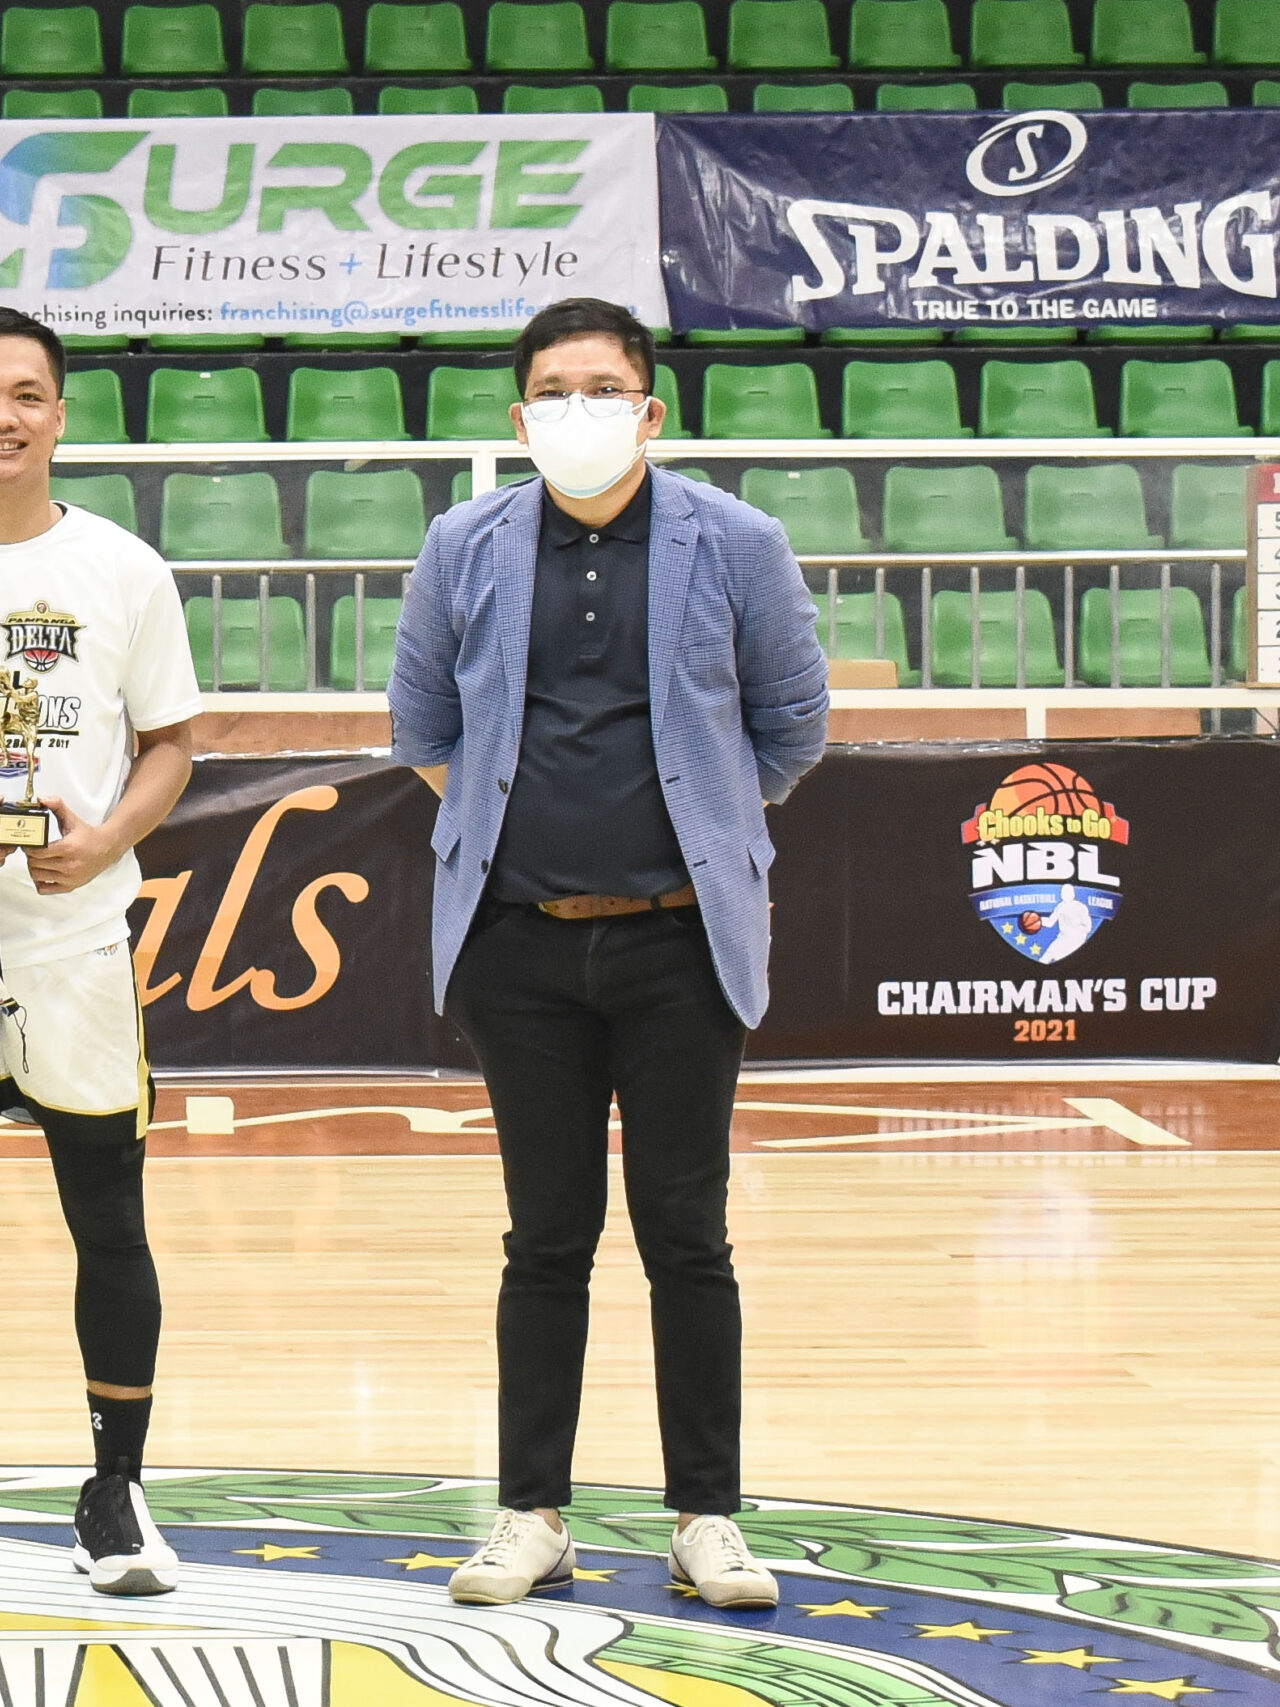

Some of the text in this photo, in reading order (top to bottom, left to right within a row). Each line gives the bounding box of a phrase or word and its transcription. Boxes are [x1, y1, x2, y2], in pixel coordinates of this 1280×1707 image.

[152, 244, 327, 281] Fitness
[376, 241, 579, 287] Lifestyle
[786, 191, 1280, 302] SPALDING
[114, 302, 212, 329] inquiries:
[913, 298, 1157, 320] TRUE TO THE GAME
[11, 624, 73, 651] DELTA
[978, 806, 1112, 844] Chooks to Go
[972, 841, 1120, 888] NBL
[877, 977, 1217, 1016] CHAIRMAN'S CUP
[1013, 1018, 1078, 1042] 2021
